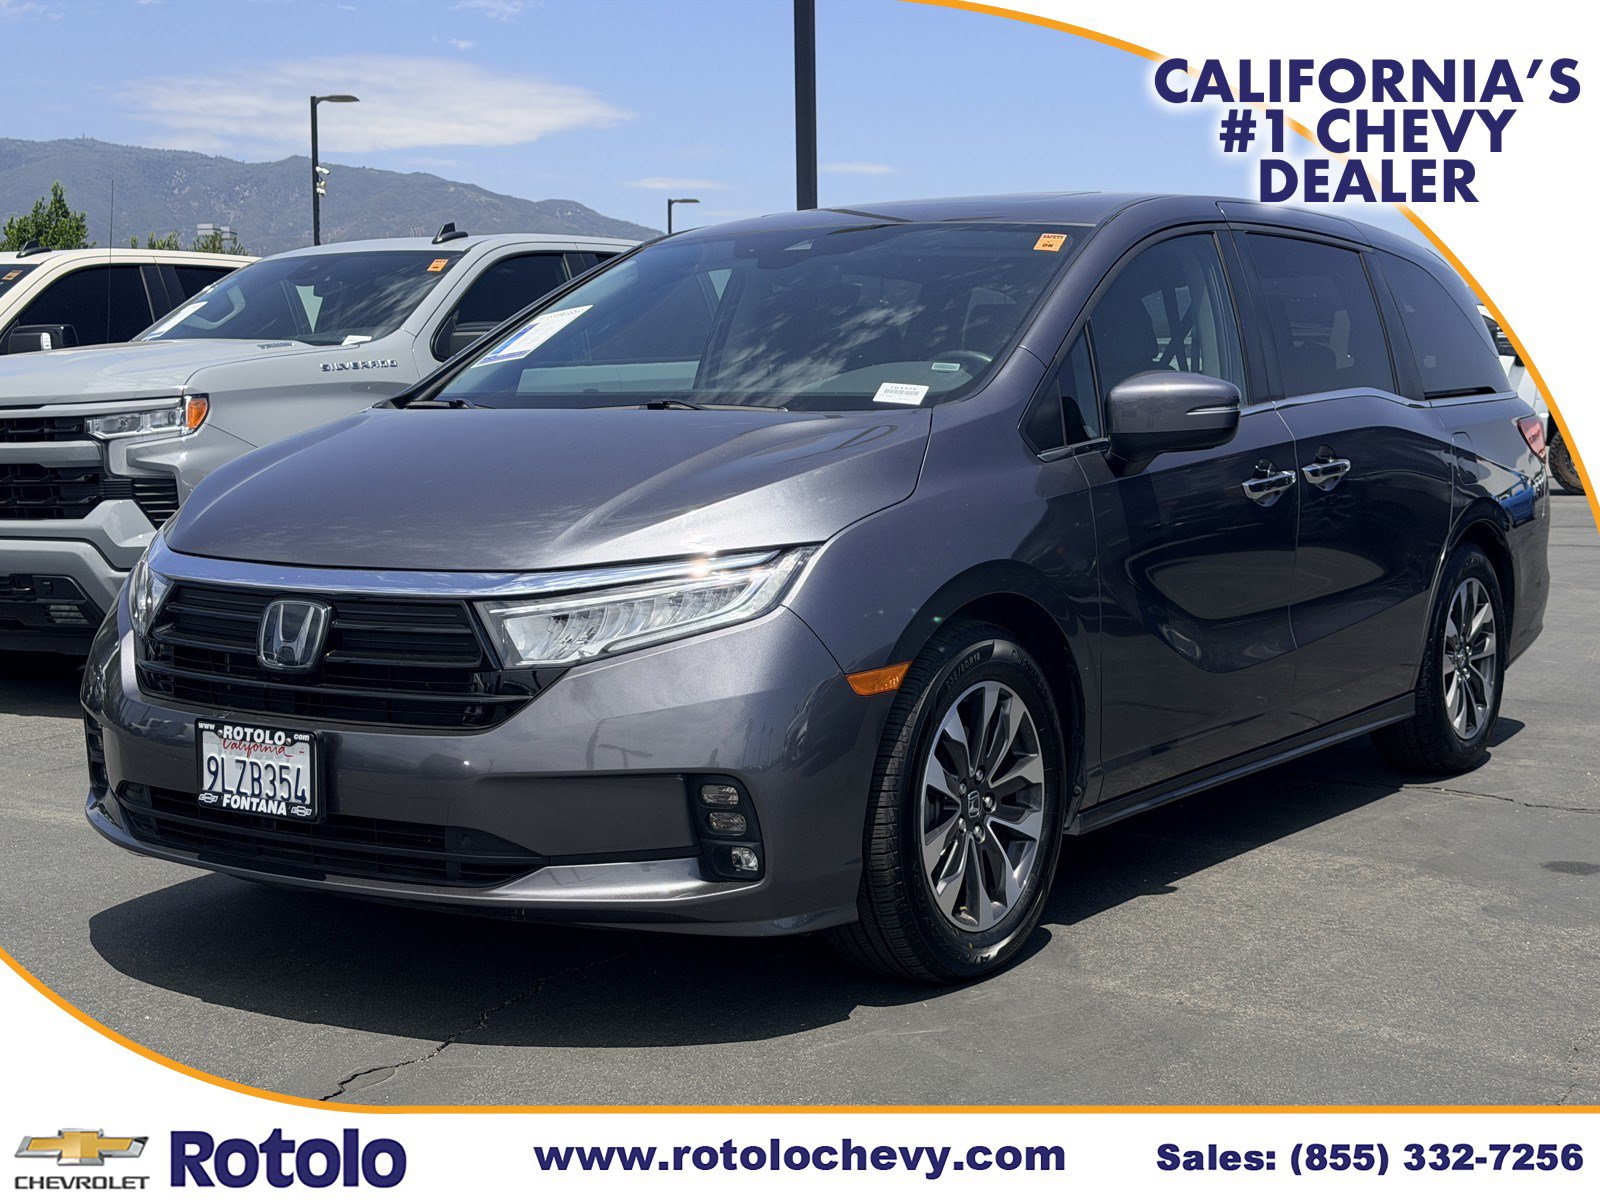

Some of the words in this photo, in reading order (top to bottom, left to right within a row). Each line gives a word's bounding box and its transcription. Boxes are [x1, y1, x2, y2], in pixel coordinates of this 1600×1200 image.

[320, 359, 398, 372] SILVERADO
[223, 725, 286, 745] ROTOLO
[222, 738, 293, 758] California
[206, 755, 308, 804] 9LZB354
[222, 793, 287, 816] FONTANA
